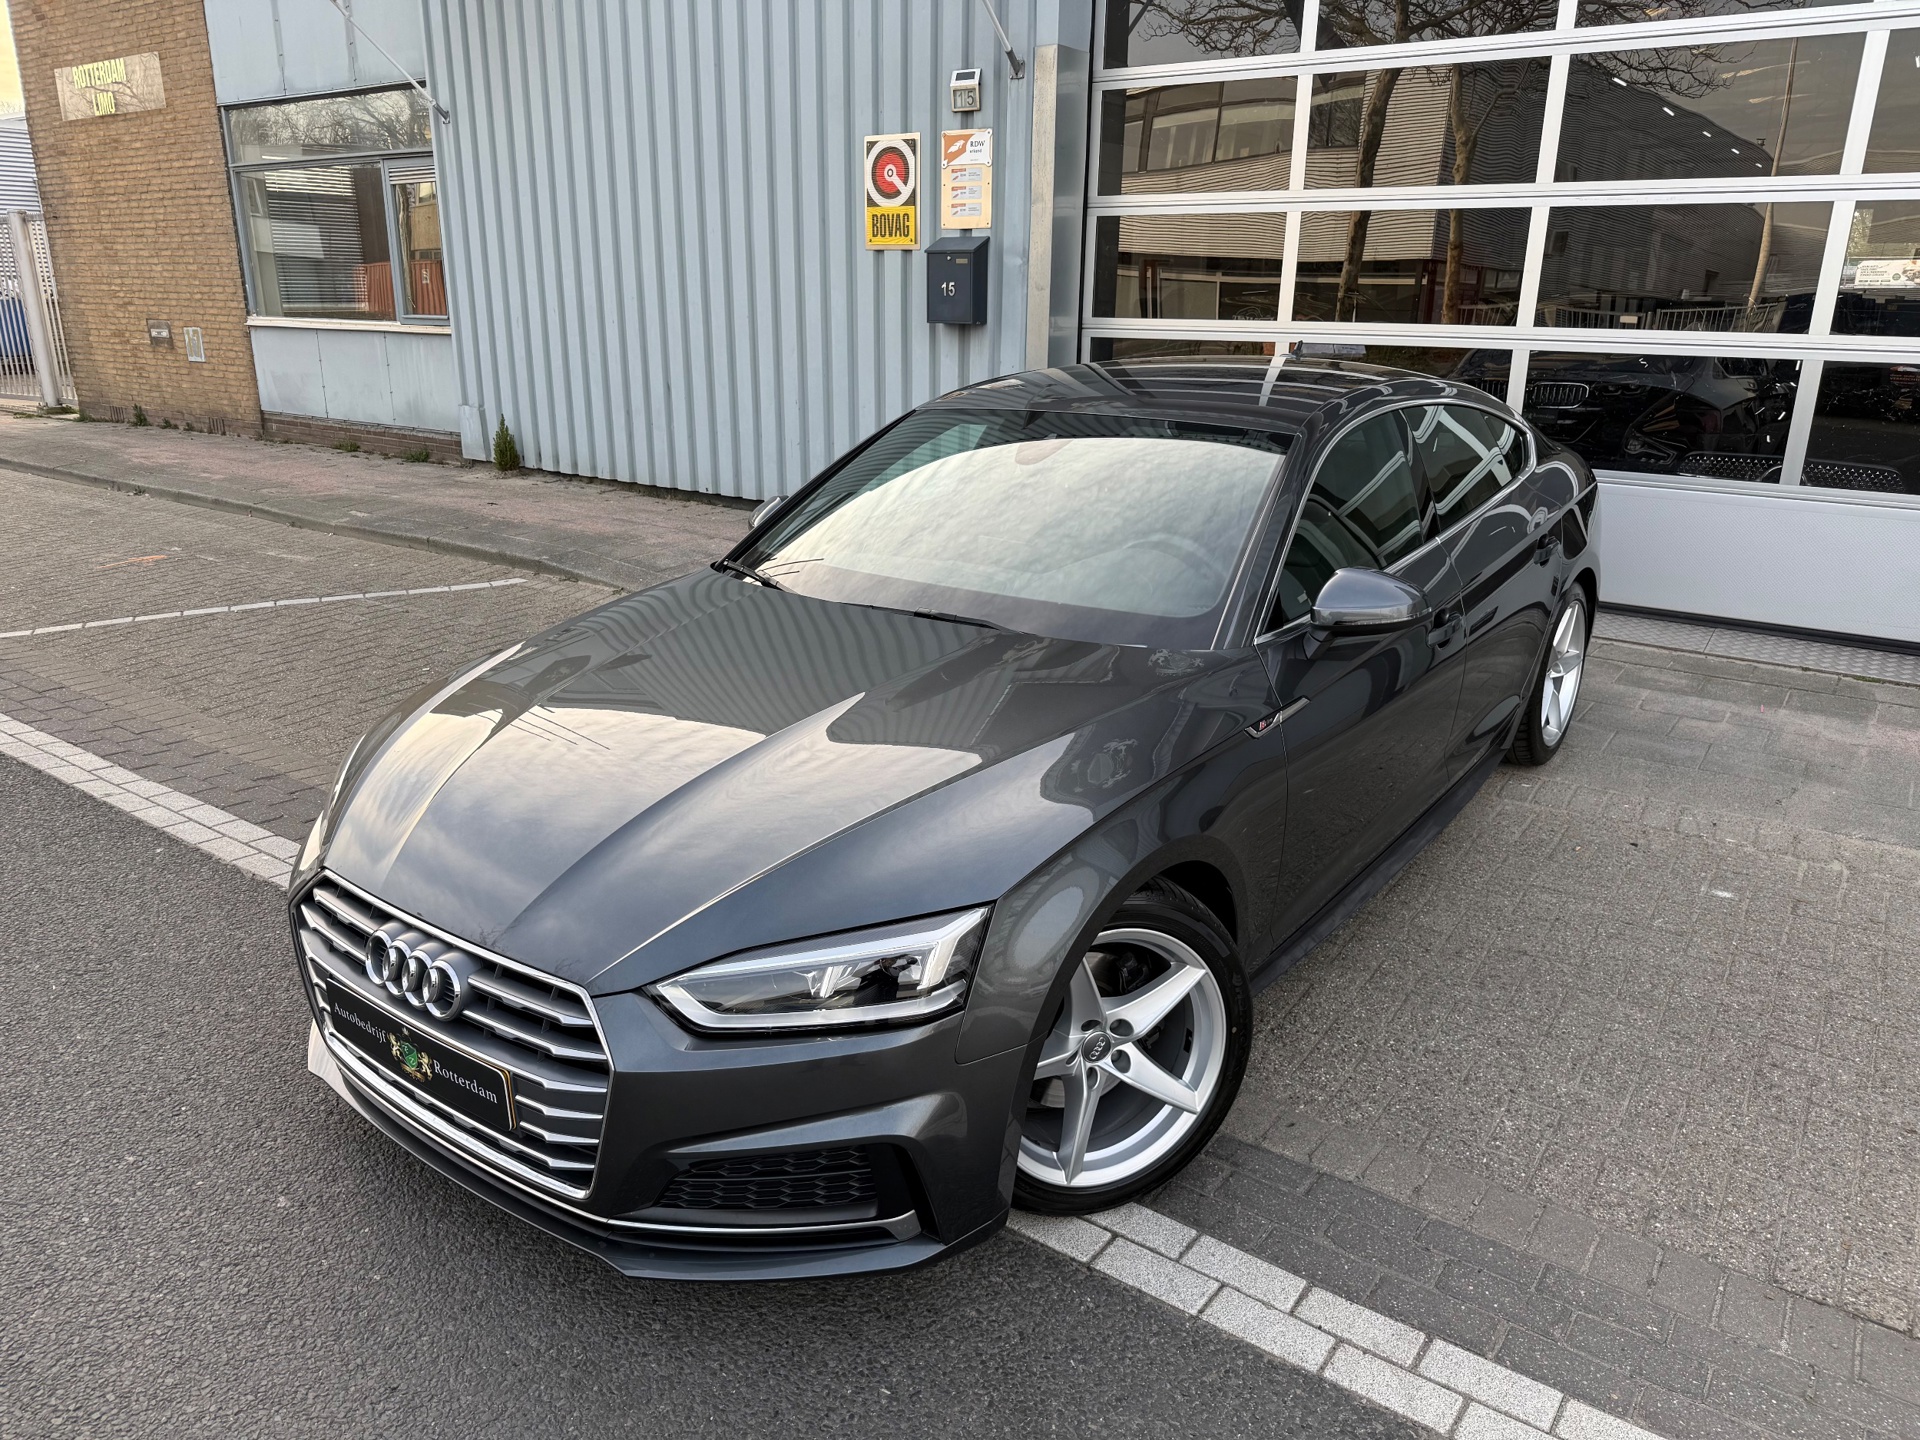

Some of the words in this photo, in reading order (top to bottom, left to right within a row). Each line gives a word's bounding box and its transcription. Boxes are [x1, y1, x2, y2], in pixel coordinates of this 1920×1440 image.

[72, 58, 126, 88] ROTTERDAM
[92, 92, 115, 116] LIMO
[958, 90, 975, 106] 15
[970, 140, 986, 148] RDW
[872, 213, 910, 237] BOVAG
[941, 281, 955, 296] 15
[334, 1002, 387, 1043] Autobedrijf
[433, 1059, 497, 1104] Rotterdam
